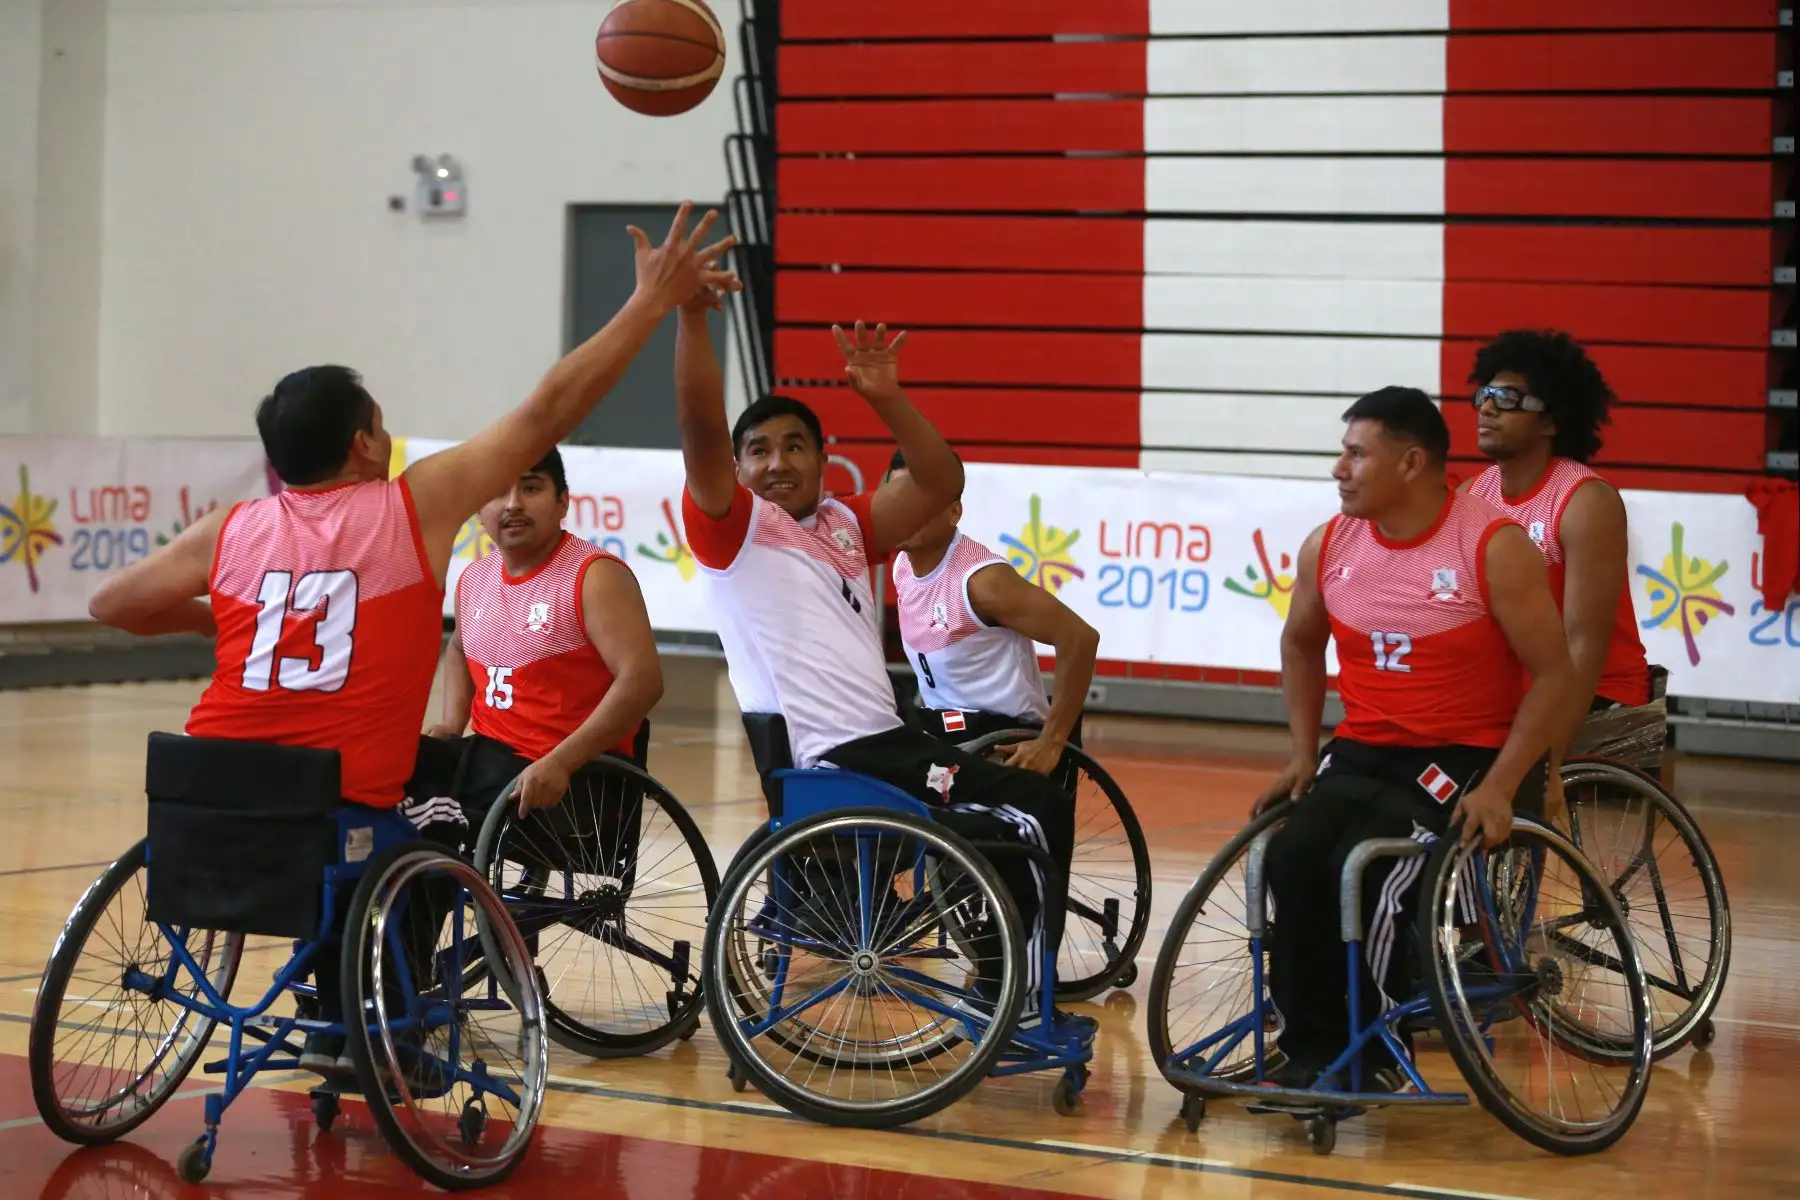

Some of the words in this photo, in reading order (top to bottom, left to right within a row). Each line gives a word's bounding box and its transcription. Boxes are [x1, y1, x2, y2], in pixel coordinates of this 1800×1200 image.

[566, 493, 625, 532] ma
[71, 528, 149, 570] 2019
[1097, 563, 1210, 612] 2019
[241, 568, 359, 694] 13
[1370, 630, 1412, 673] 12
[485, 665, 514, 710] 15
[917, 652, 936, 689] 9
